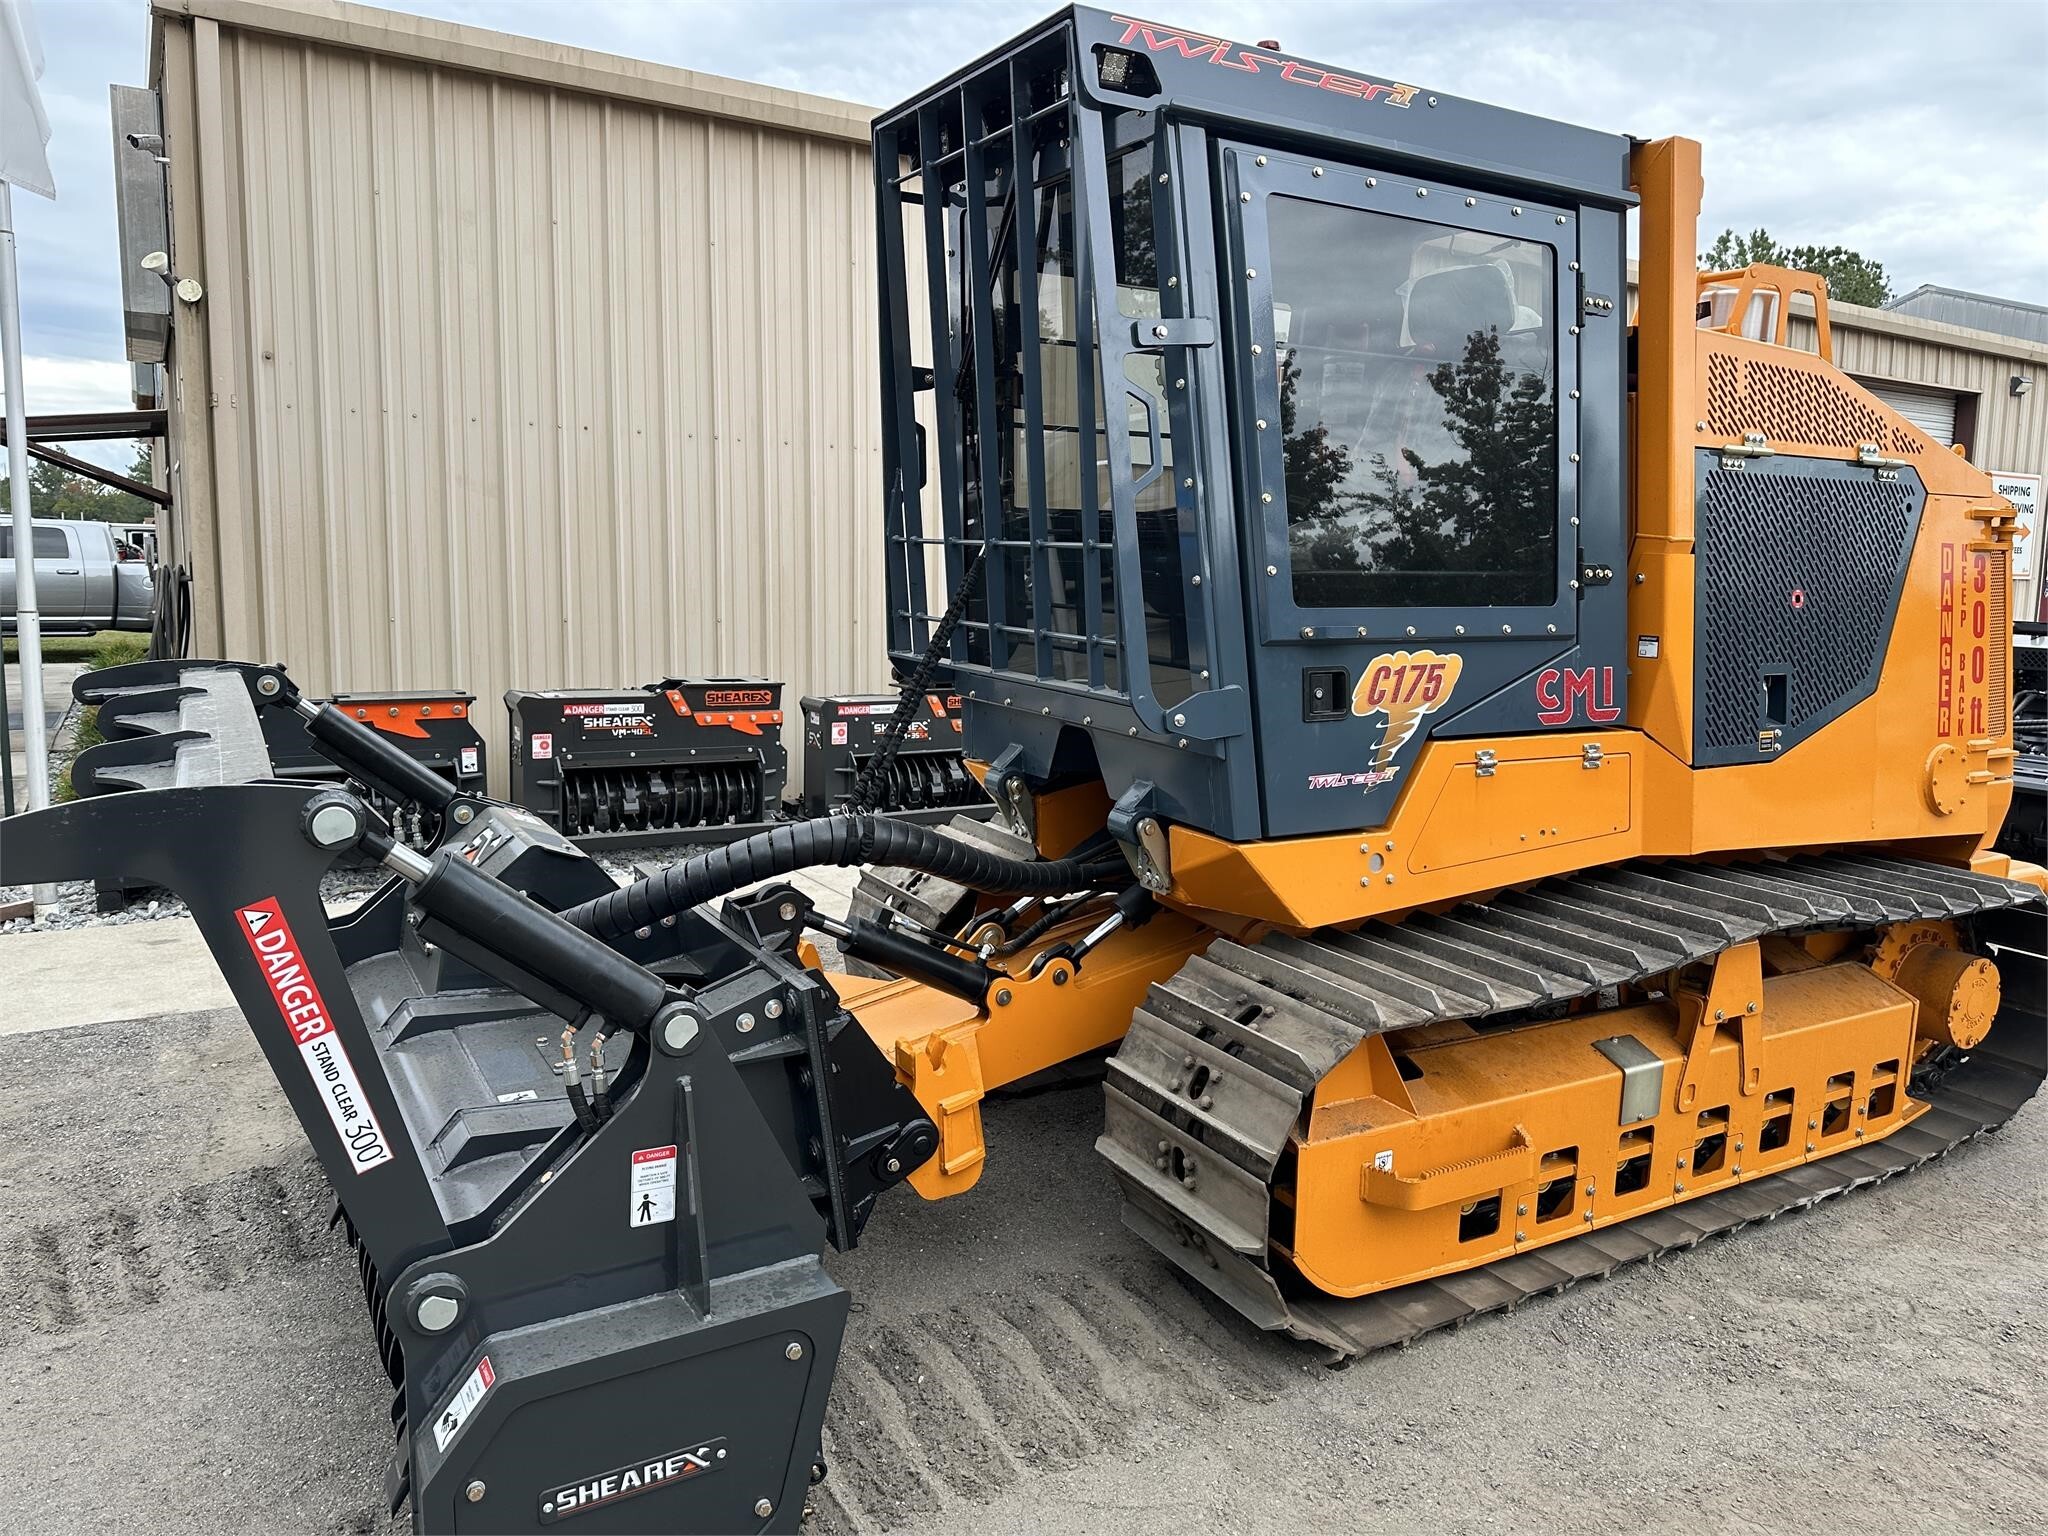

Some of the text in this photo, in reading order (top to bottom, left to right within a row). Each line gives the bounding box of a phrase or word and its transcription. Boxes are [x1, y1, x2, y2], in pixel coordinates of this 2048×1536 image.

[1998, 484, 2031, 497] SHIPPING
[1938, 543, 1954, 737] DANGER
[1957, 543, 1968, 737] KEEP BACK
[1972, 553, 1987, 685] 300
[707, 691, 770, 704] SHEAREX
[1367, 663, 1447, 706] C175
[1536, 666, 1621, 726] CMI
[572, 705, 604, 715] DANGER
[583, 715, 654, 728] SHEAREX
[844, 705, 871, 715] DANGER
[254, 927, 327, 1042] DANGER
[311, 1041, 340, 1082] STAND
[331, 1083, 359, 1122] CLEAR
[645, 1150, 670, 1160] DANGER
[556, 1447, 711, 1511] SHEAREX
